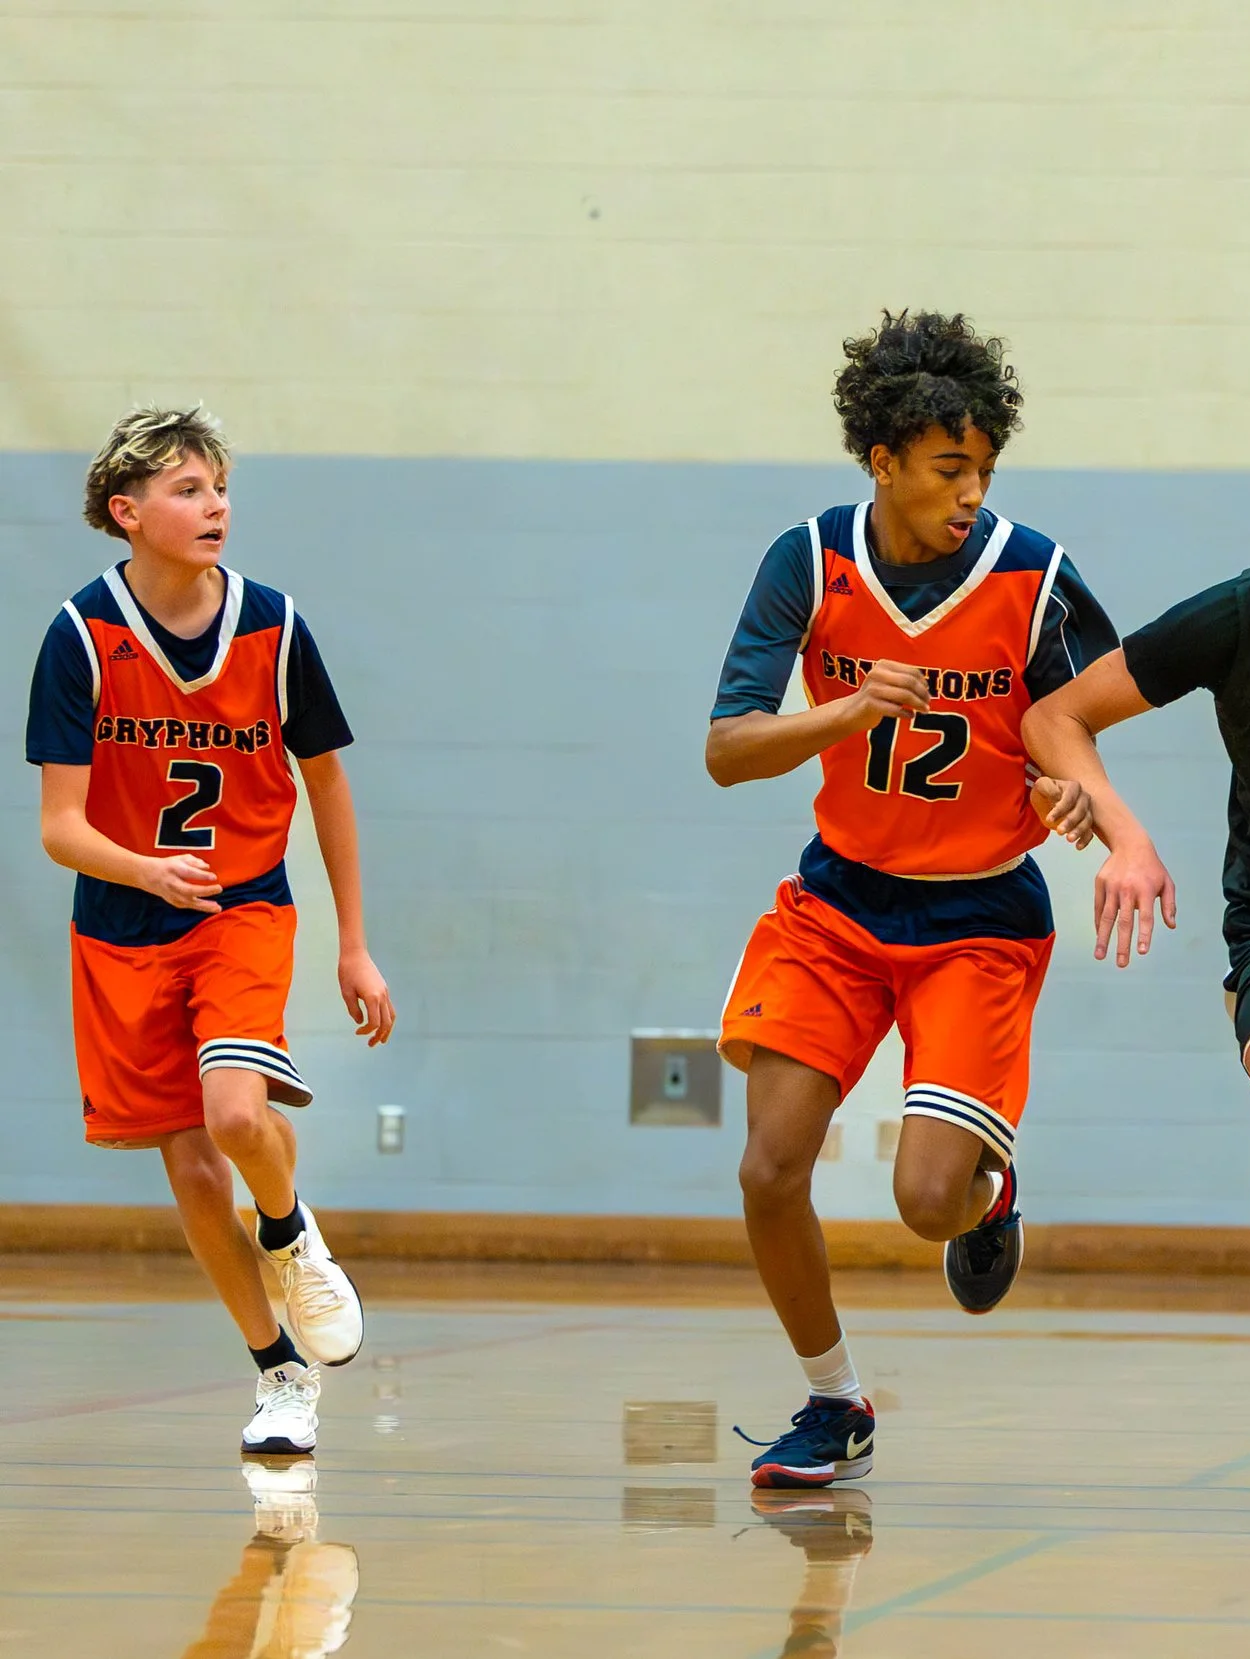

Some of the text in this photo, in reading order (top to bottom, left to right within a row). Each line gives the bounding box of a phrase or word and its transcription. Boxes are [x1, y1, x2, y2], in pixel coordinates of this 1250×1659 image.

[820, 649, 1013, 701] GRHONS
[96, 716, 271, 754] GRYPHONS
[865, 711, 970, 802] 12
[155, 760, 223, 849] 2
